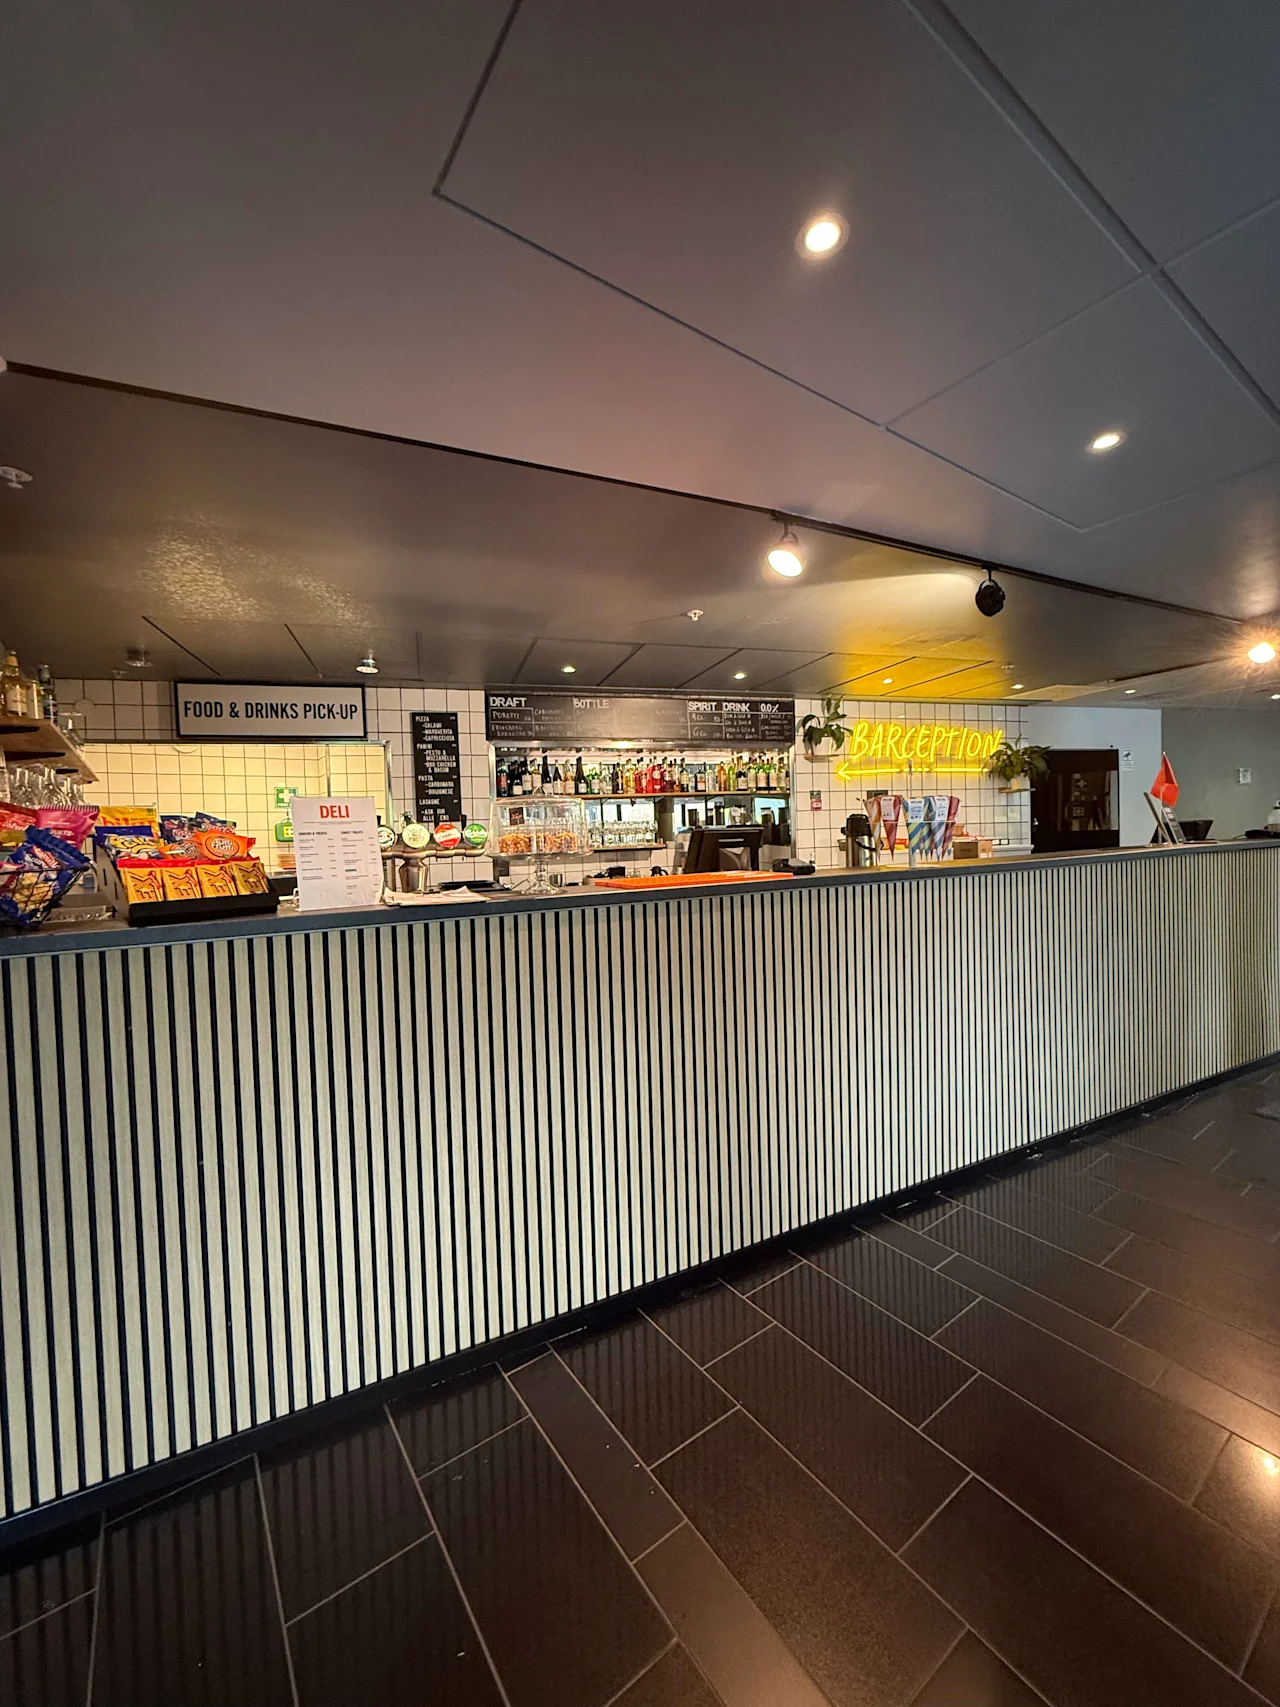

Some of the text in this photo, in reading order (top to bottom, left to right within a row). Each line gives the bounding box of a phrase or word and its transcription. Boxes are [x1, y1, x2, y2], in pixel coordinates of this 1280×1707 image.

[489, 697, 527, 707] DRAFT
[573, 698, 610, 709] BOTTLE
[688, 702, 717, 711] SPIRIT
[722, 703, 750, 712] DRINK
[184, 701, 358, 720] FOOD & DRINKS PICK-UP
[851, 720, 1003, 762] BARCEPTION
[319, 805, 350, 819] DELI
